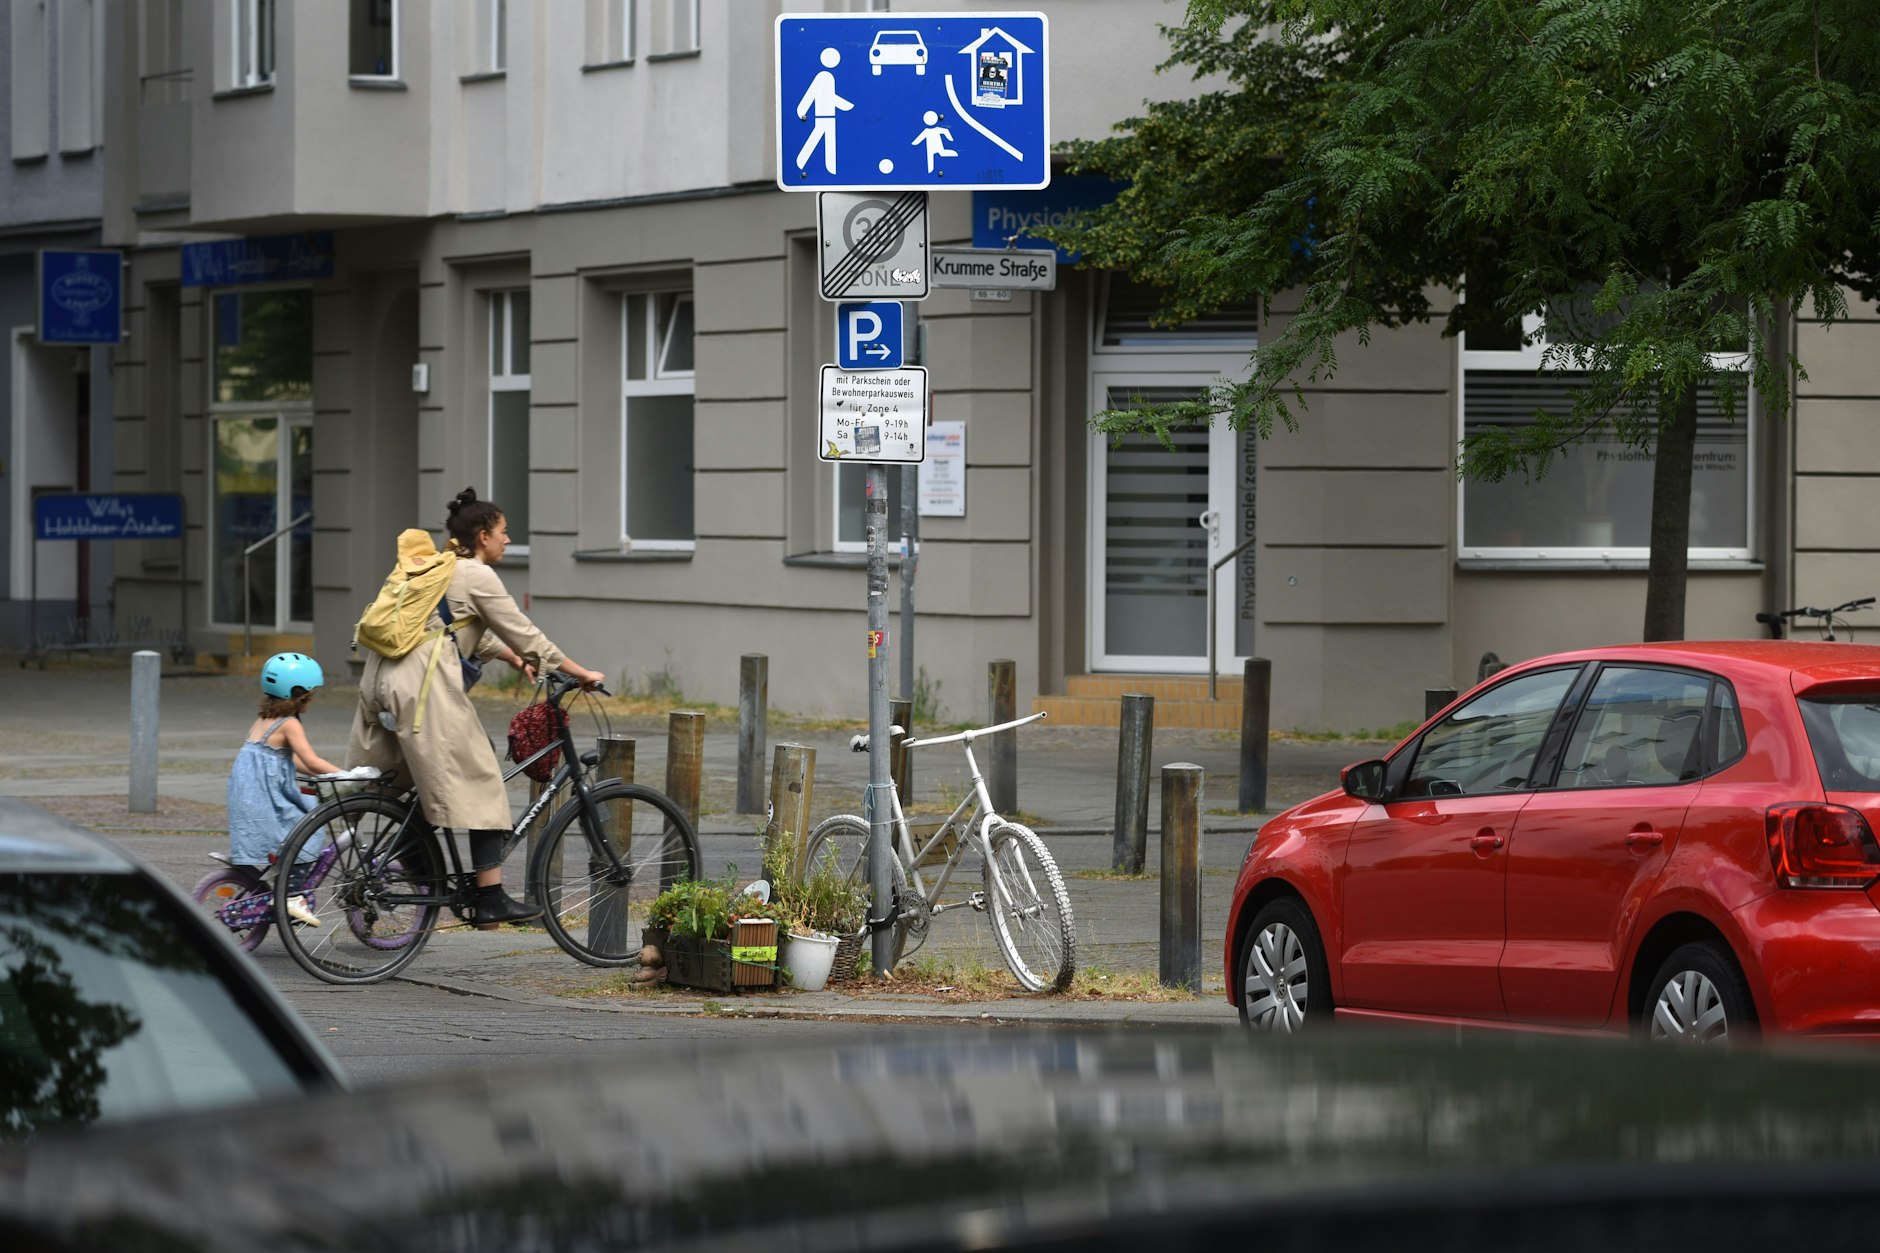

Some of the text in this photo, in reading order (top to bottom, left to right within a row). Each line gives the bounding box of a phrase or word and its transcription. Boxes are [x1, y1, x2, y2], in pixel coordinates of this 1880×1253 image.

[856, 216, 897, 248] 30
[933, 256, 995, 276] Krumme
[999, 258, 1048, 282] Straße
[849, 311, 883, 361] P
[836, 375, 911, 386] mit Parkschein oder
[832, 387, 914, 399] Bewohnerparkausweis
[849, 403, 898, 413] für Zone 4
[836, 418, 908, 428] Mo-Fr 9-19h
[837, 430, 908, 441] Sa 9-14h
